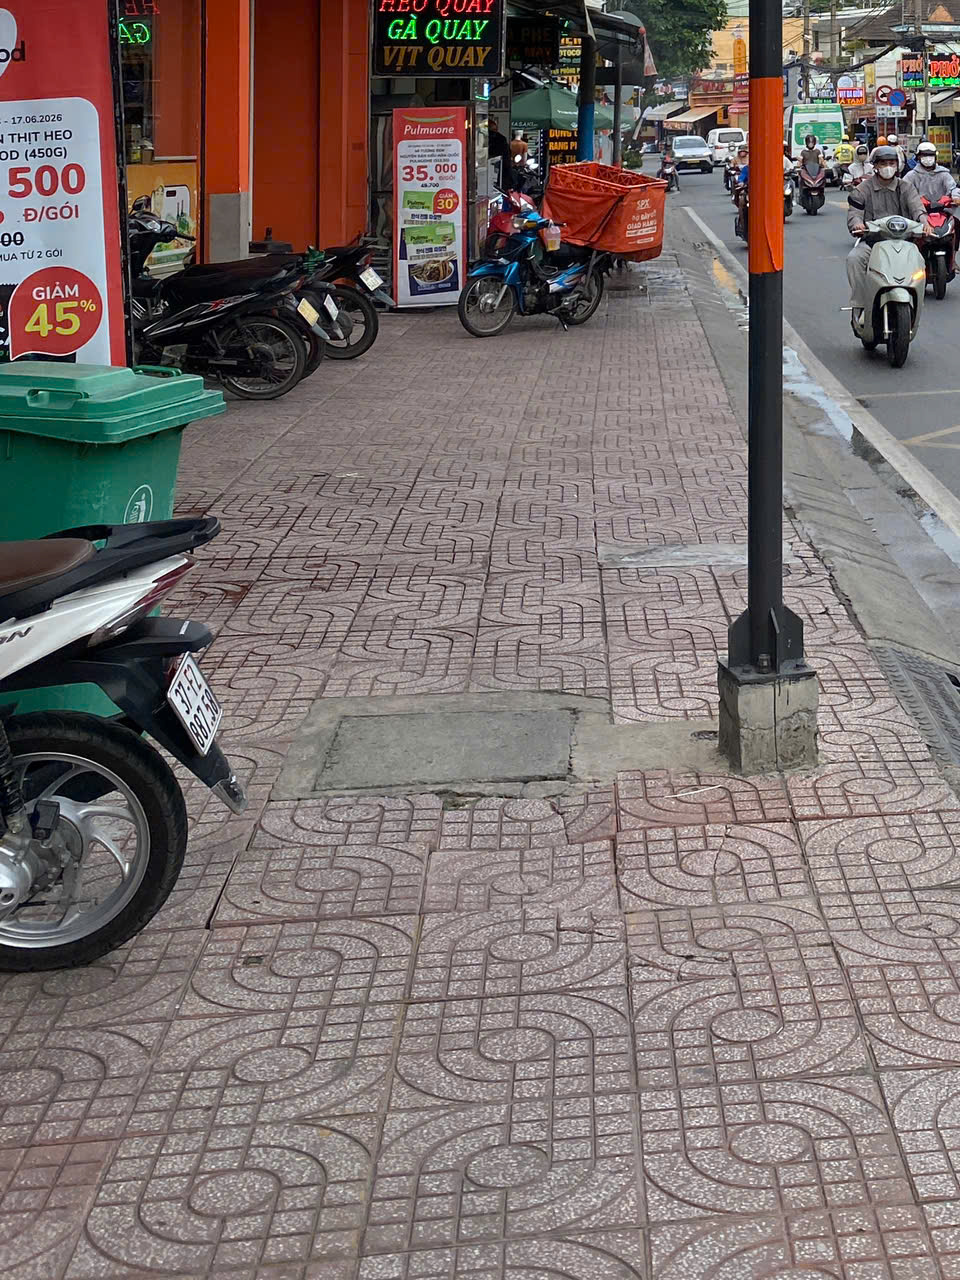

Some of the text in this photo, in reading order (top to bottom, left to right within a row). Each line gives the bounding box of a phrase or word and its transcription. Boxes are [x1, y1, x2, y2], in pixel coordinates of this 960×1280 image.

[388, 14, 489, 44] GÀ QUAY
[383, 45, 493, 72] VỊT QUAY
[930, 54, 960, 77] PHỞ
[12, 114, 62, 124] 17.06.2026
[8, 130, 72, 144] THỊT HEO
[403, 124, 455, 136] Pulmuone
[25, 147, 67, 161] (450G)
[8, 163, 85, 198] 500
[23, 202, 78, 222] Đ/GÓI
[20, 250, 34, 260] TỪ
[46, 248, 62, 258] GÓI
[32, 282, 79, 300] GIẢM
[174, 664, 202, 715] 37-F2
[189, 688, 219, 749] 887.58
